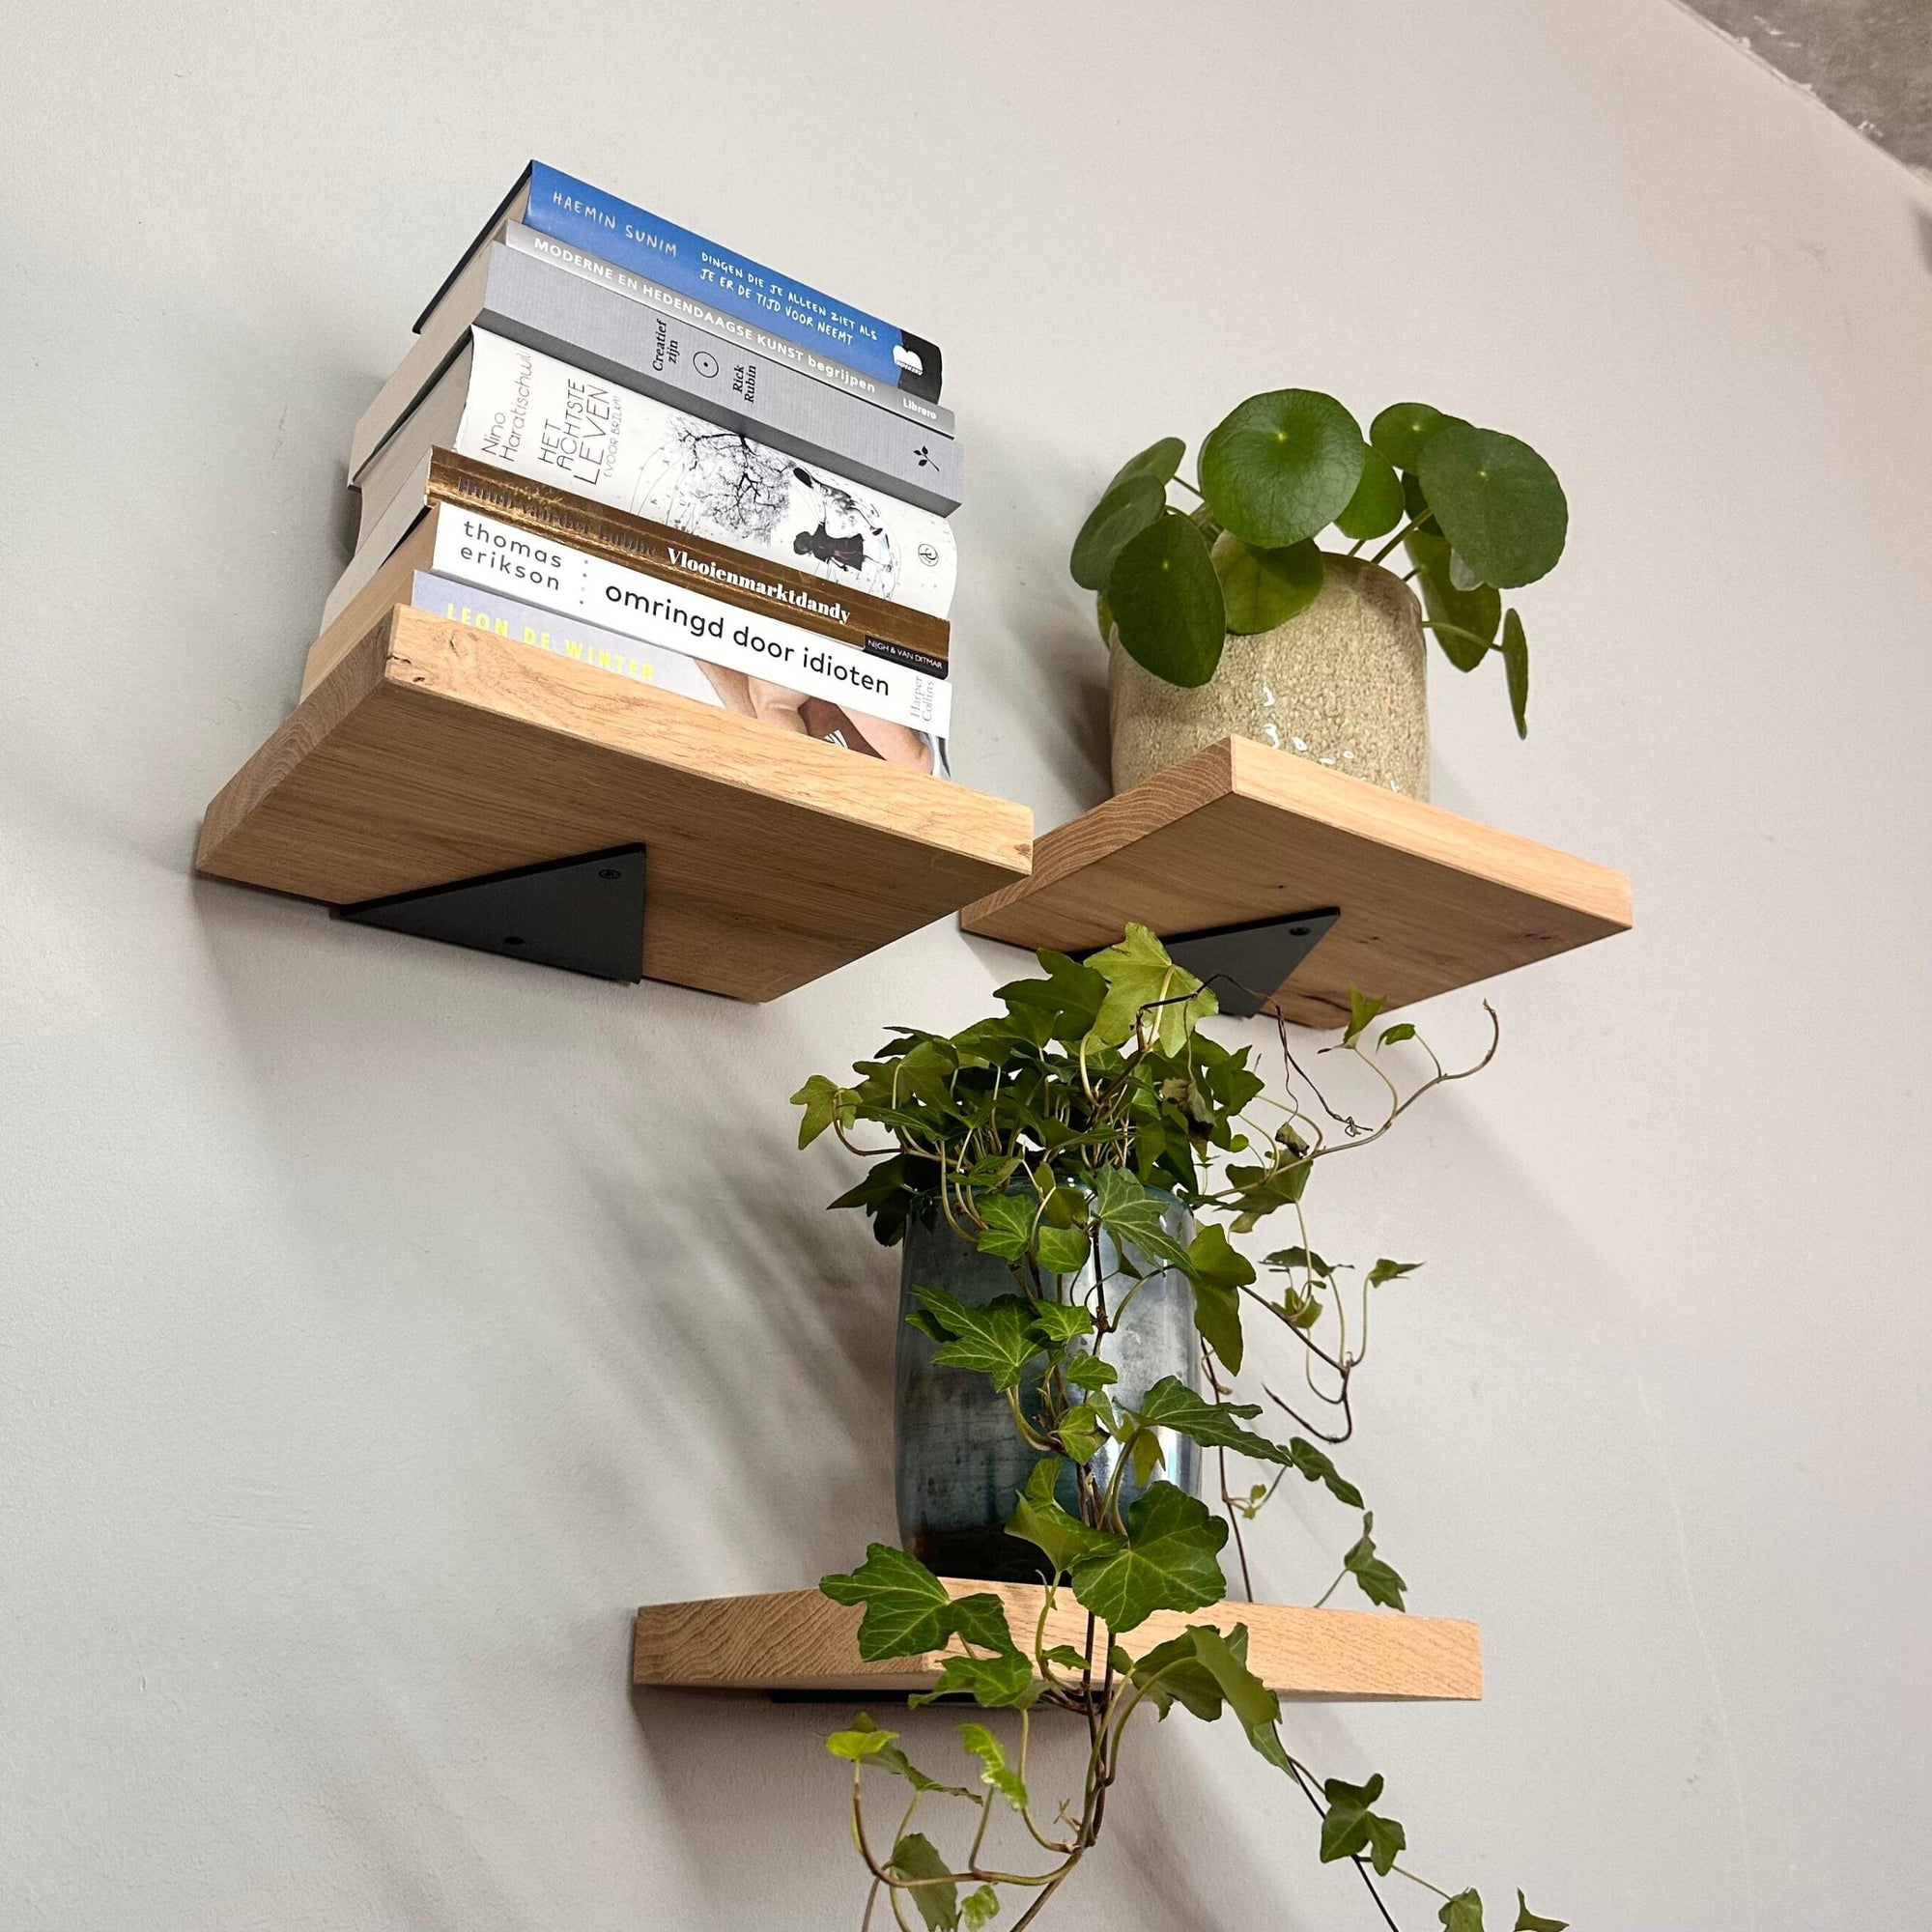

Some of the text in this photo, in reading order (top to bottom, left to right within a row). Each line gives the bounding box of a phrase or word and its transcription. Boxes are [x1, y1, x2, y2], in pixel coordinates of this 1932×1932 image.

[553, 190, 677, 258] HAEMIN SUNIM
[534, 238, 876, 394] MODERNE EN HEDENDAAGSE KUNST begrijpen
[699, 269, 854, 347] JE ER DE TIJD VOOR NEEMT
[701, 251, 878, 341] DINGEN DIE JE ALLEEN ZIET ALS
[652, 318, 668, 372] Creatief
[668, 339, 681, 365] zijn
[732, 363, 745, 394] Rick
[744, 364, 756, 404] Rubin
[555, 378, 585, 471] ACHTSTE
[902, 397, 938, 420] Librero
[481, 412, 506, 456] Nino
[537, 418, 561, 465] HET
[573, 384, 611, 486] LEVEN
[603, 438, 619, 478] (VOOR
[464, 520, 563, 568] thomas
[460, 546, 560, 591] erikson
[667, 546, 852, 626] Vlooienmarktdandy
[445, 603, 509, 638] LEON
[523, 626, 551, 651] DE
[605, 584, 890, 696] omringd door idioten
[890, 646, 896, 655] &
[897, 648, 915, 661] VAN
[915, 654, 943, 669] DITMAR
[910, 675, 923, 718] Harper
[921, 681, 935, 722] Collins
